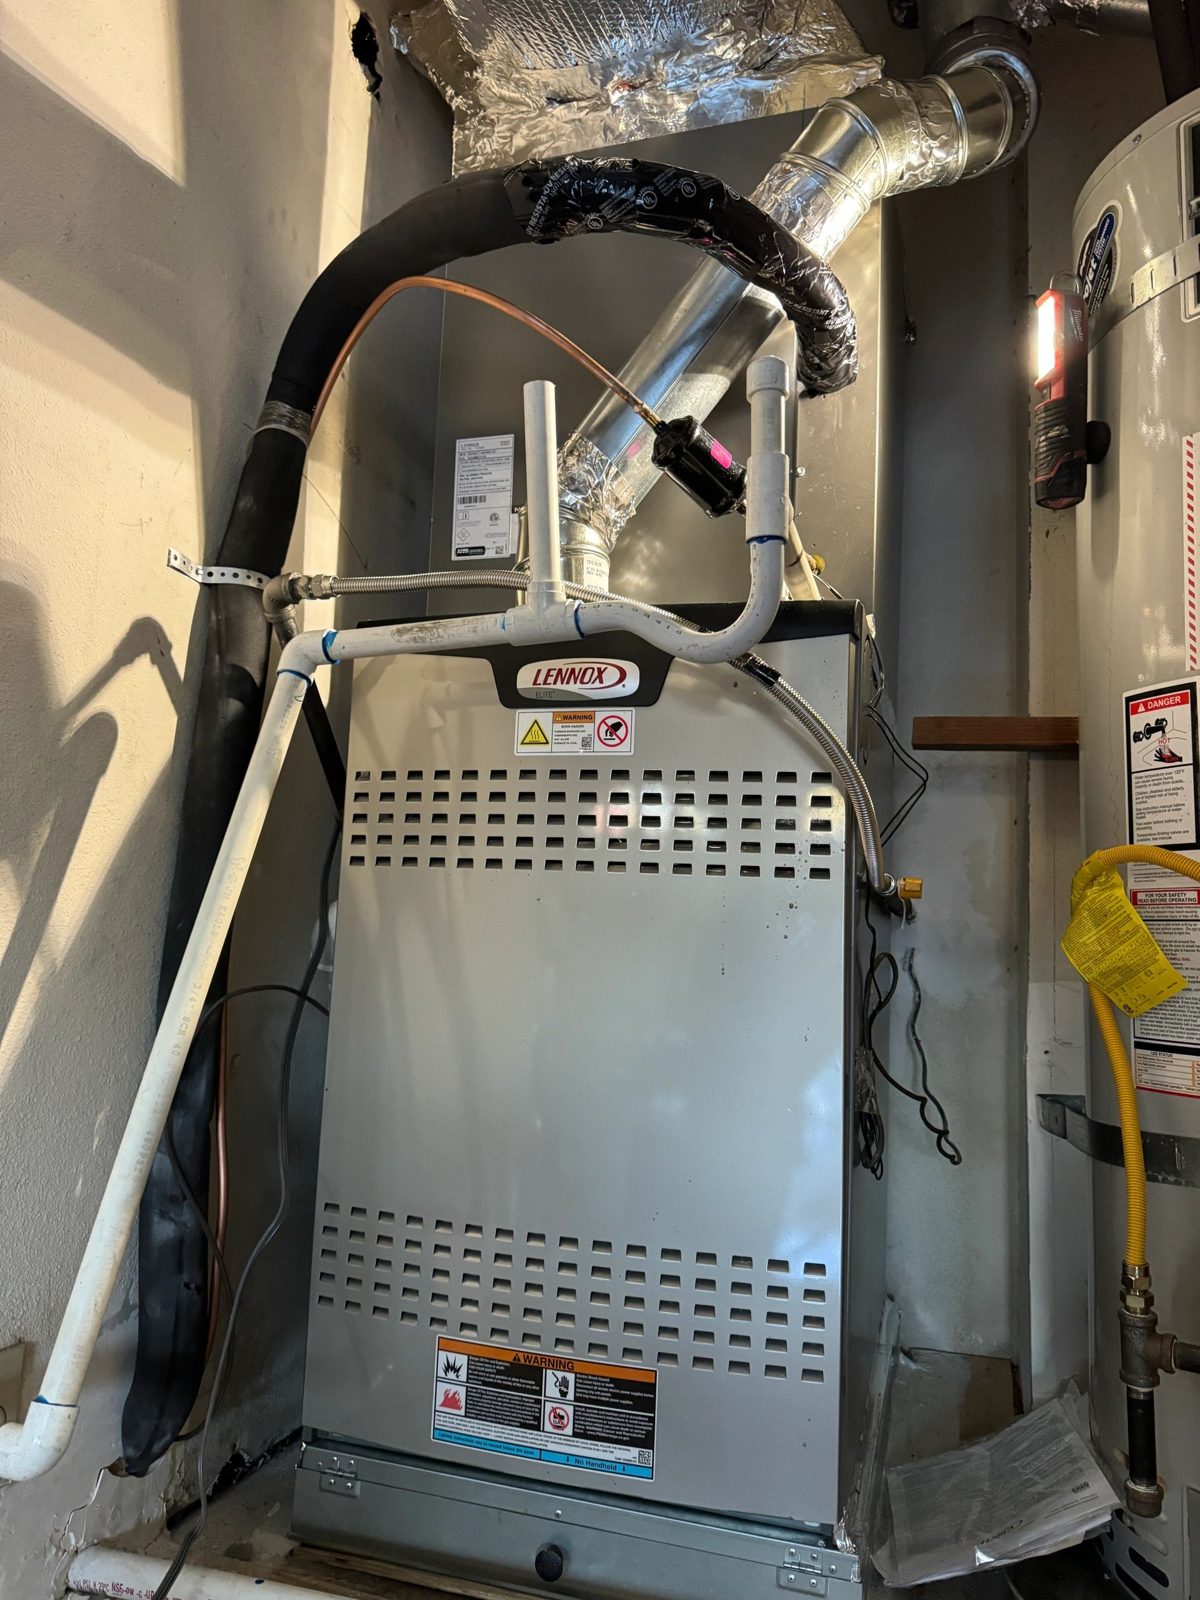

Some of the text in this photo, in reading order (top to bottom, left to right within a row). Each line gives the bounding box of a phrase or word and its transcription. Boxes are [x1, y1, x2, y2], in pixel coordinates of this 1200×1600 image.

[528, 195, 548, 227] RESISTA
[532, 666, 608, 686] LENNOX
[1148, 695, 1181, 710] DANGER
[523, 1354, 574, 1370] WARNING
[585, 1460, 616, 1471] Handhold
